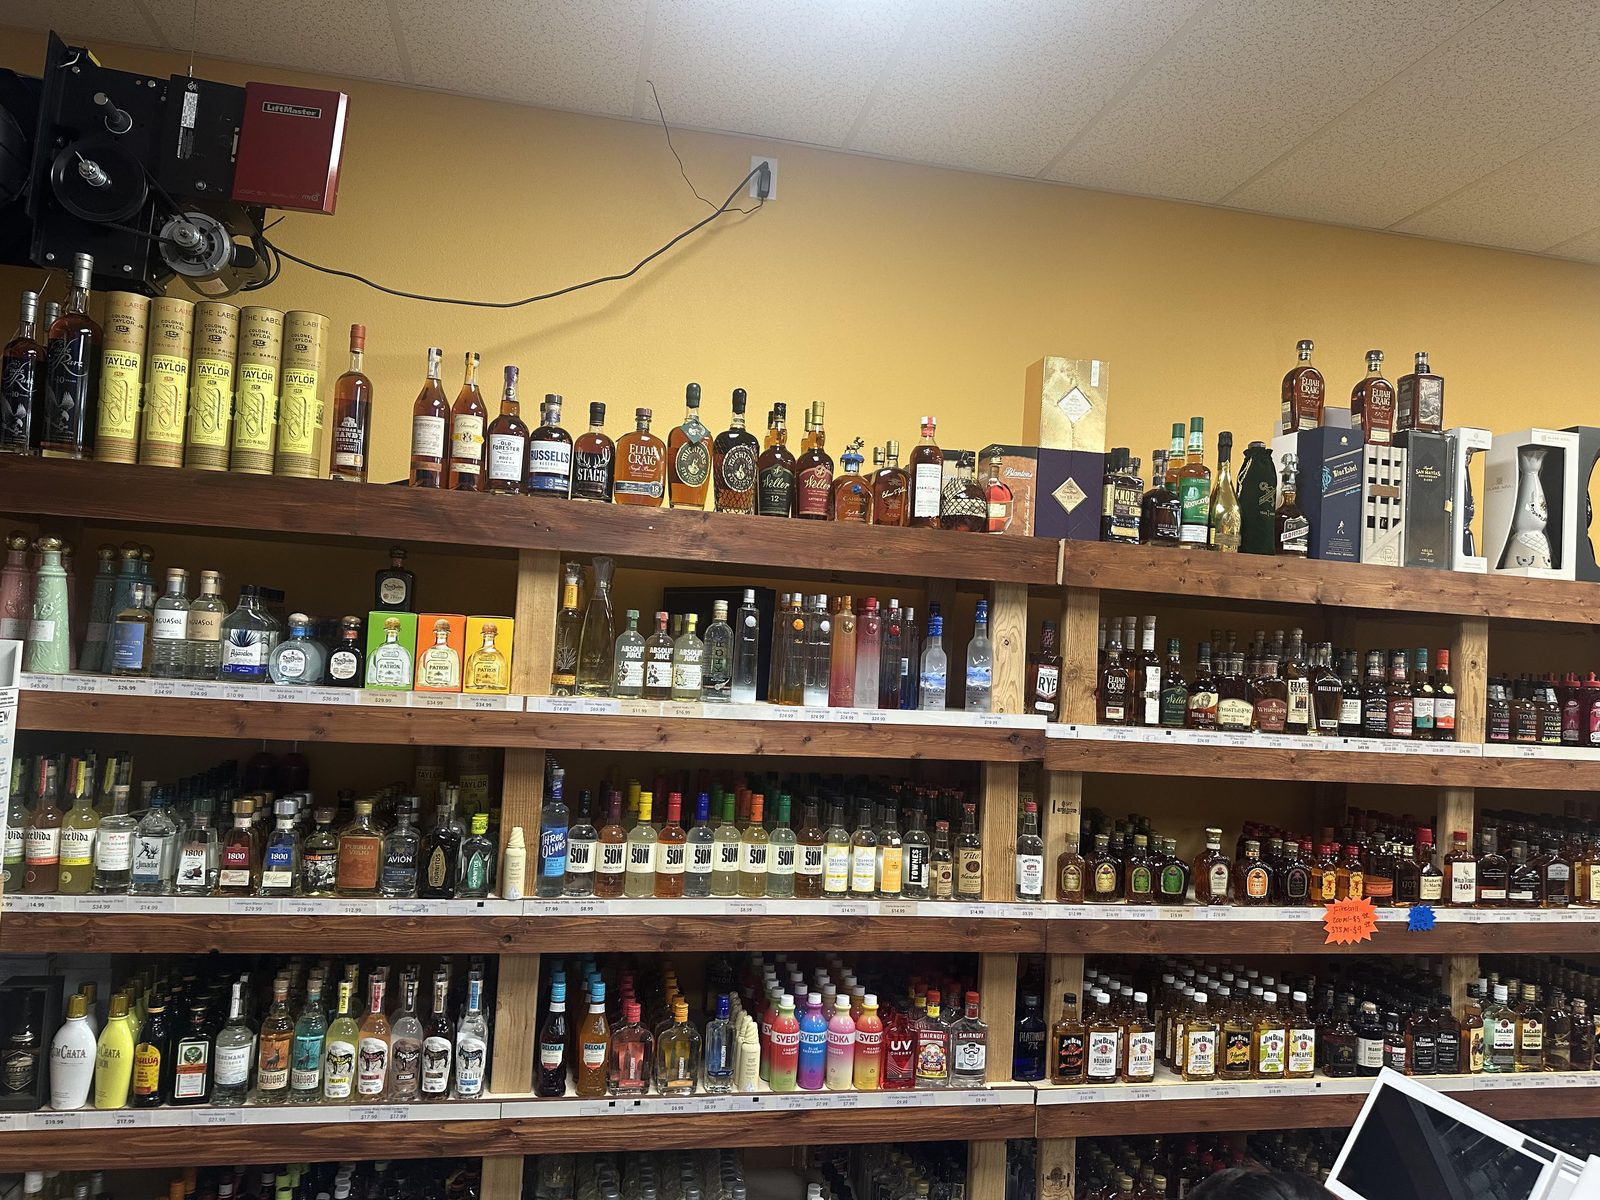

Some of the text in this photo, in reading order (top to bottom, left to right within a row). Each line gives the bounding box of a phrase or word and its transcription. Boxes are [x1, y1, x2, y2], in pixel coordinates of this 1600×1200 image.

[267, 104, 317, 116] LiftMaster
[105, 357, 138, 369] TAYLOR
[154, 361, 187, 374] TAYLOR
[198, 365, 230, 378] TAYLOR
[242, 370, 273, 382] TAYLOR
[285, 374, 315, 385] TAYLOR
[1301, 377, 1320, 387] ELIJAH
[1301, 384, 1320, 394] CRAIG
[1372, 388, 1391, 398] ELIJAH
[1371, 396, 1391, 406] CRAIG
[492, 444, 520, 453] FORESTER
[629, 444, 656, 456] ELIJAH
[531, 449, 569, 464] RUSSELL'S
[628, 452, 656, 466] CRAIG
[577, 470, 606, 482] STAGG
[1333, 465, 1357, 478] Blue Label
[762, 475, 790, 489] Weller
[804, 475, 830, 490] Weller
[651, 485, 659, 493] 18
[1115, 489, 1135, 501] KNOB
[621, 645, 645, 653] ABSOLUT
[650, 646, 674, 654] ABSOLUT
[679, 648, 703, 656] ABSOLUT
[1038, 677, 1057, 691] RYE
[1108, 675, 1126, 684] ELIJAH
[1107, 682, 1125, 690] CRAIG
[541, 830, 564, 846] THREE
[185, 849, 203, 857] 1800
[542, 840, 566, 859] OLIVES
[570, 848, 589, 863] SON
[721, 848, 738, 863] SON
[228, 852, 245, 860] 1800
[388, 855, 412, 863] AVIÓN
[604, 848, 622, 864] SON
[631, 848, 649, 864] SON
[667, 849, 684, 864] SON
[694, 849, 711, 864] SON
[750, 849, 766, 864] SON
[778, 850, 794, 866] SON
[805, 850, 821, 866] SON
[911, 849, 919, 880] TOWNES
[800, 1034, 826, 1042] SVEDKA
[1063, 1037, 1082, 1047] JIM BEAM
[1092, 1036, 1115, 1047] JIM BEAM
[1132, 1036, 1153, 1047] JIM BEAM
[1192, 1036, 1213, 1046] JIM BEAM
[1263, 1033, 1283, 1043] JIM BEAM
[1293, 1033, 1313, 1043] JIM BEAM
[890, 1040, 912, 1051] UV
